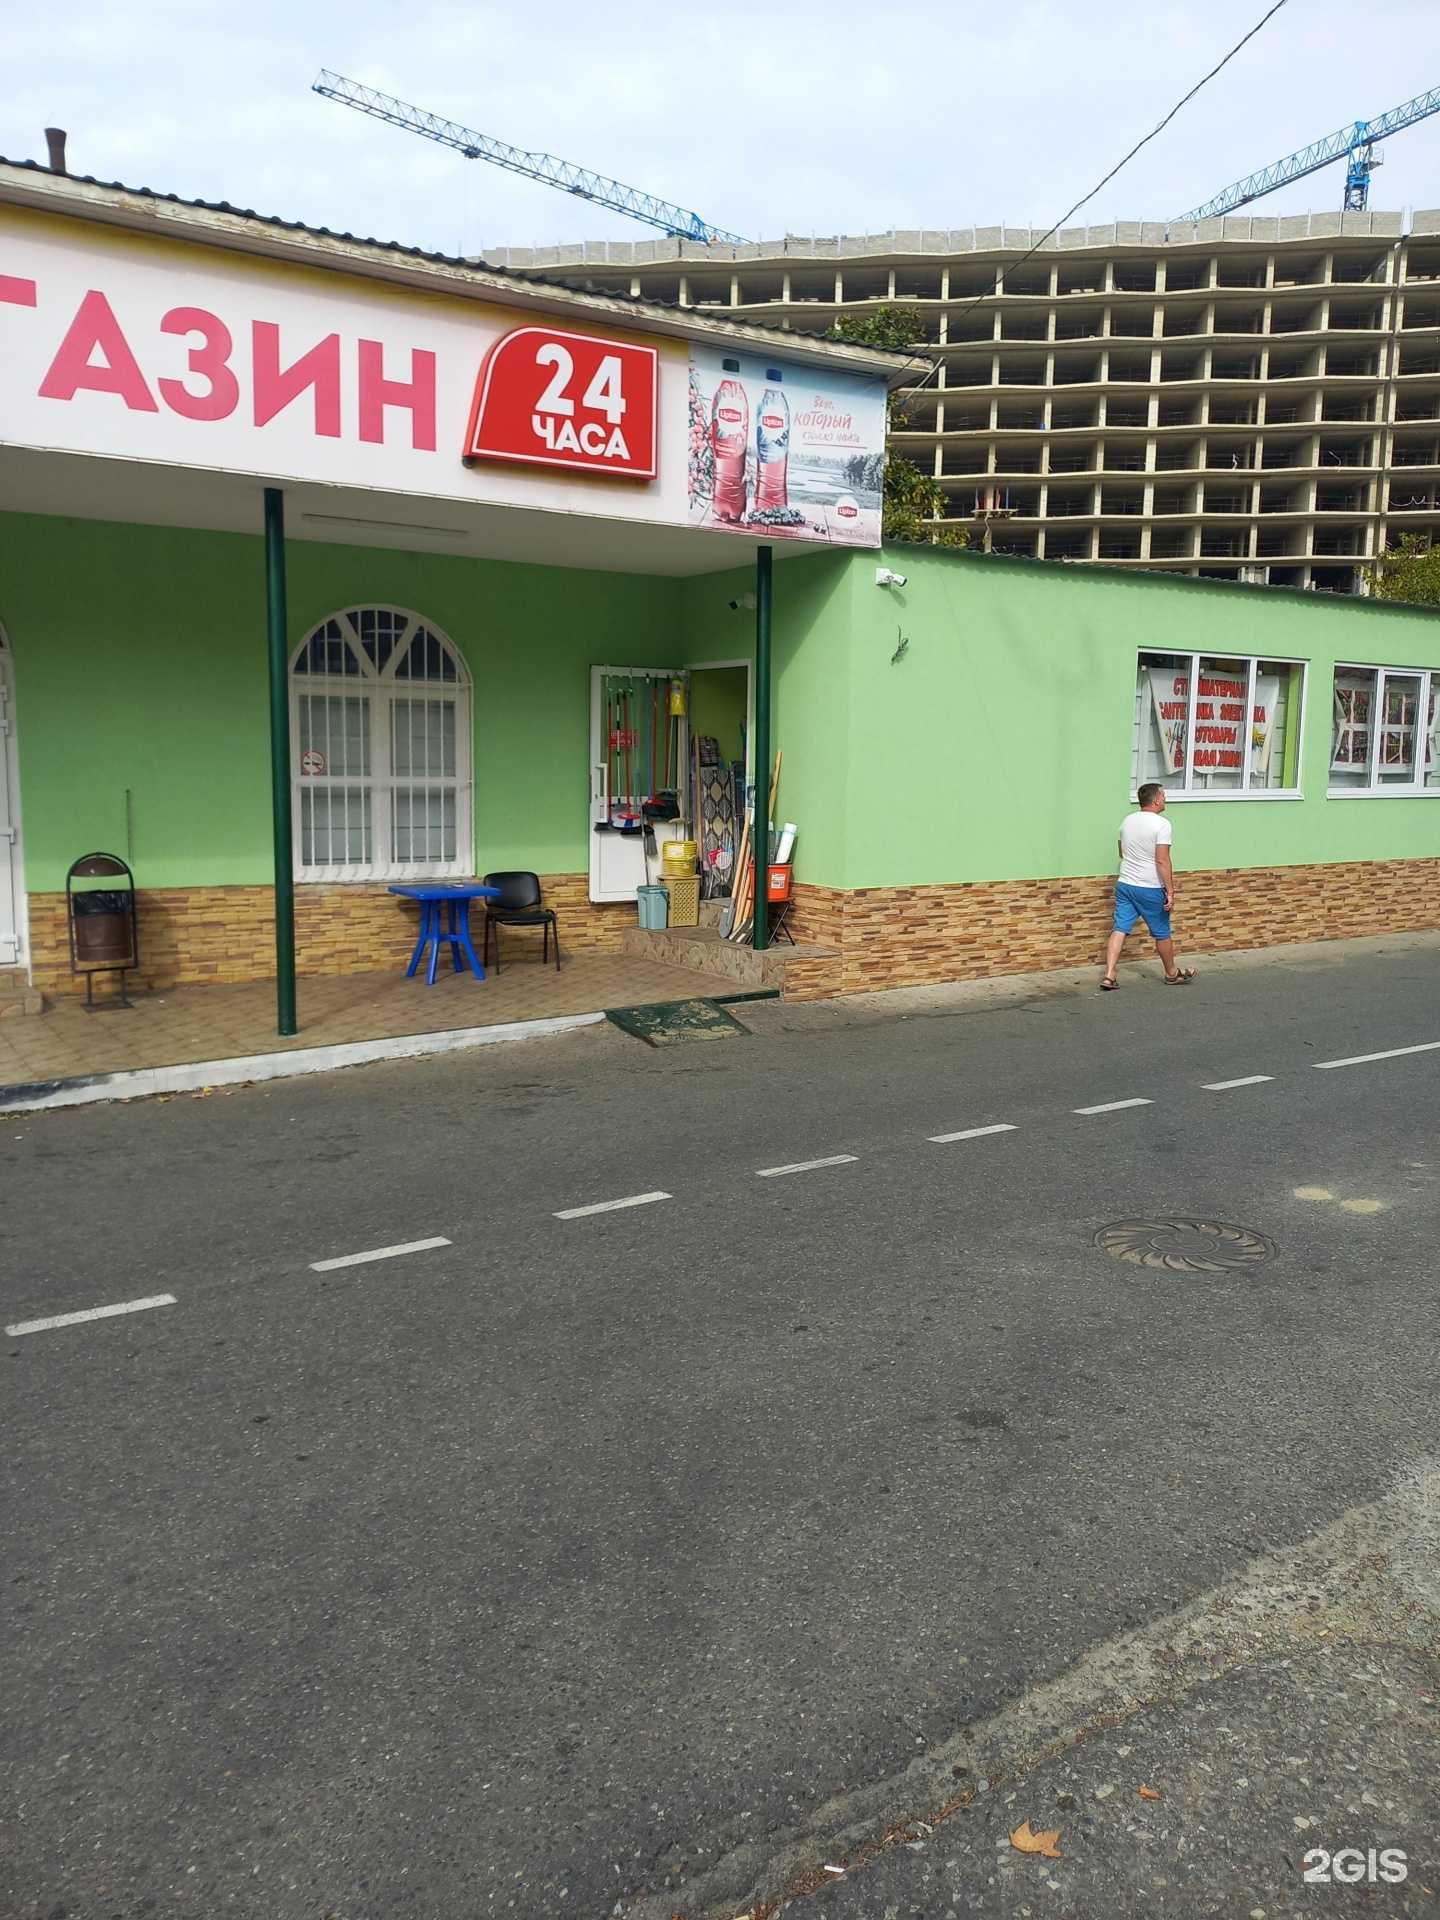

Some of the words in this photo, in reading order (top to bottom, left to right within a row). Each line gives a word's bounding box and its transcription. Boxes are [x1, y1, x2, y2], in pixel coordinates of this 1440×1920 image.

[534, 342, 626, 424] 24
[720, 410, 741, 421] Lipton
[794, 411, 852, 430] который
[531, 415, 630, 460] ЧАСА
